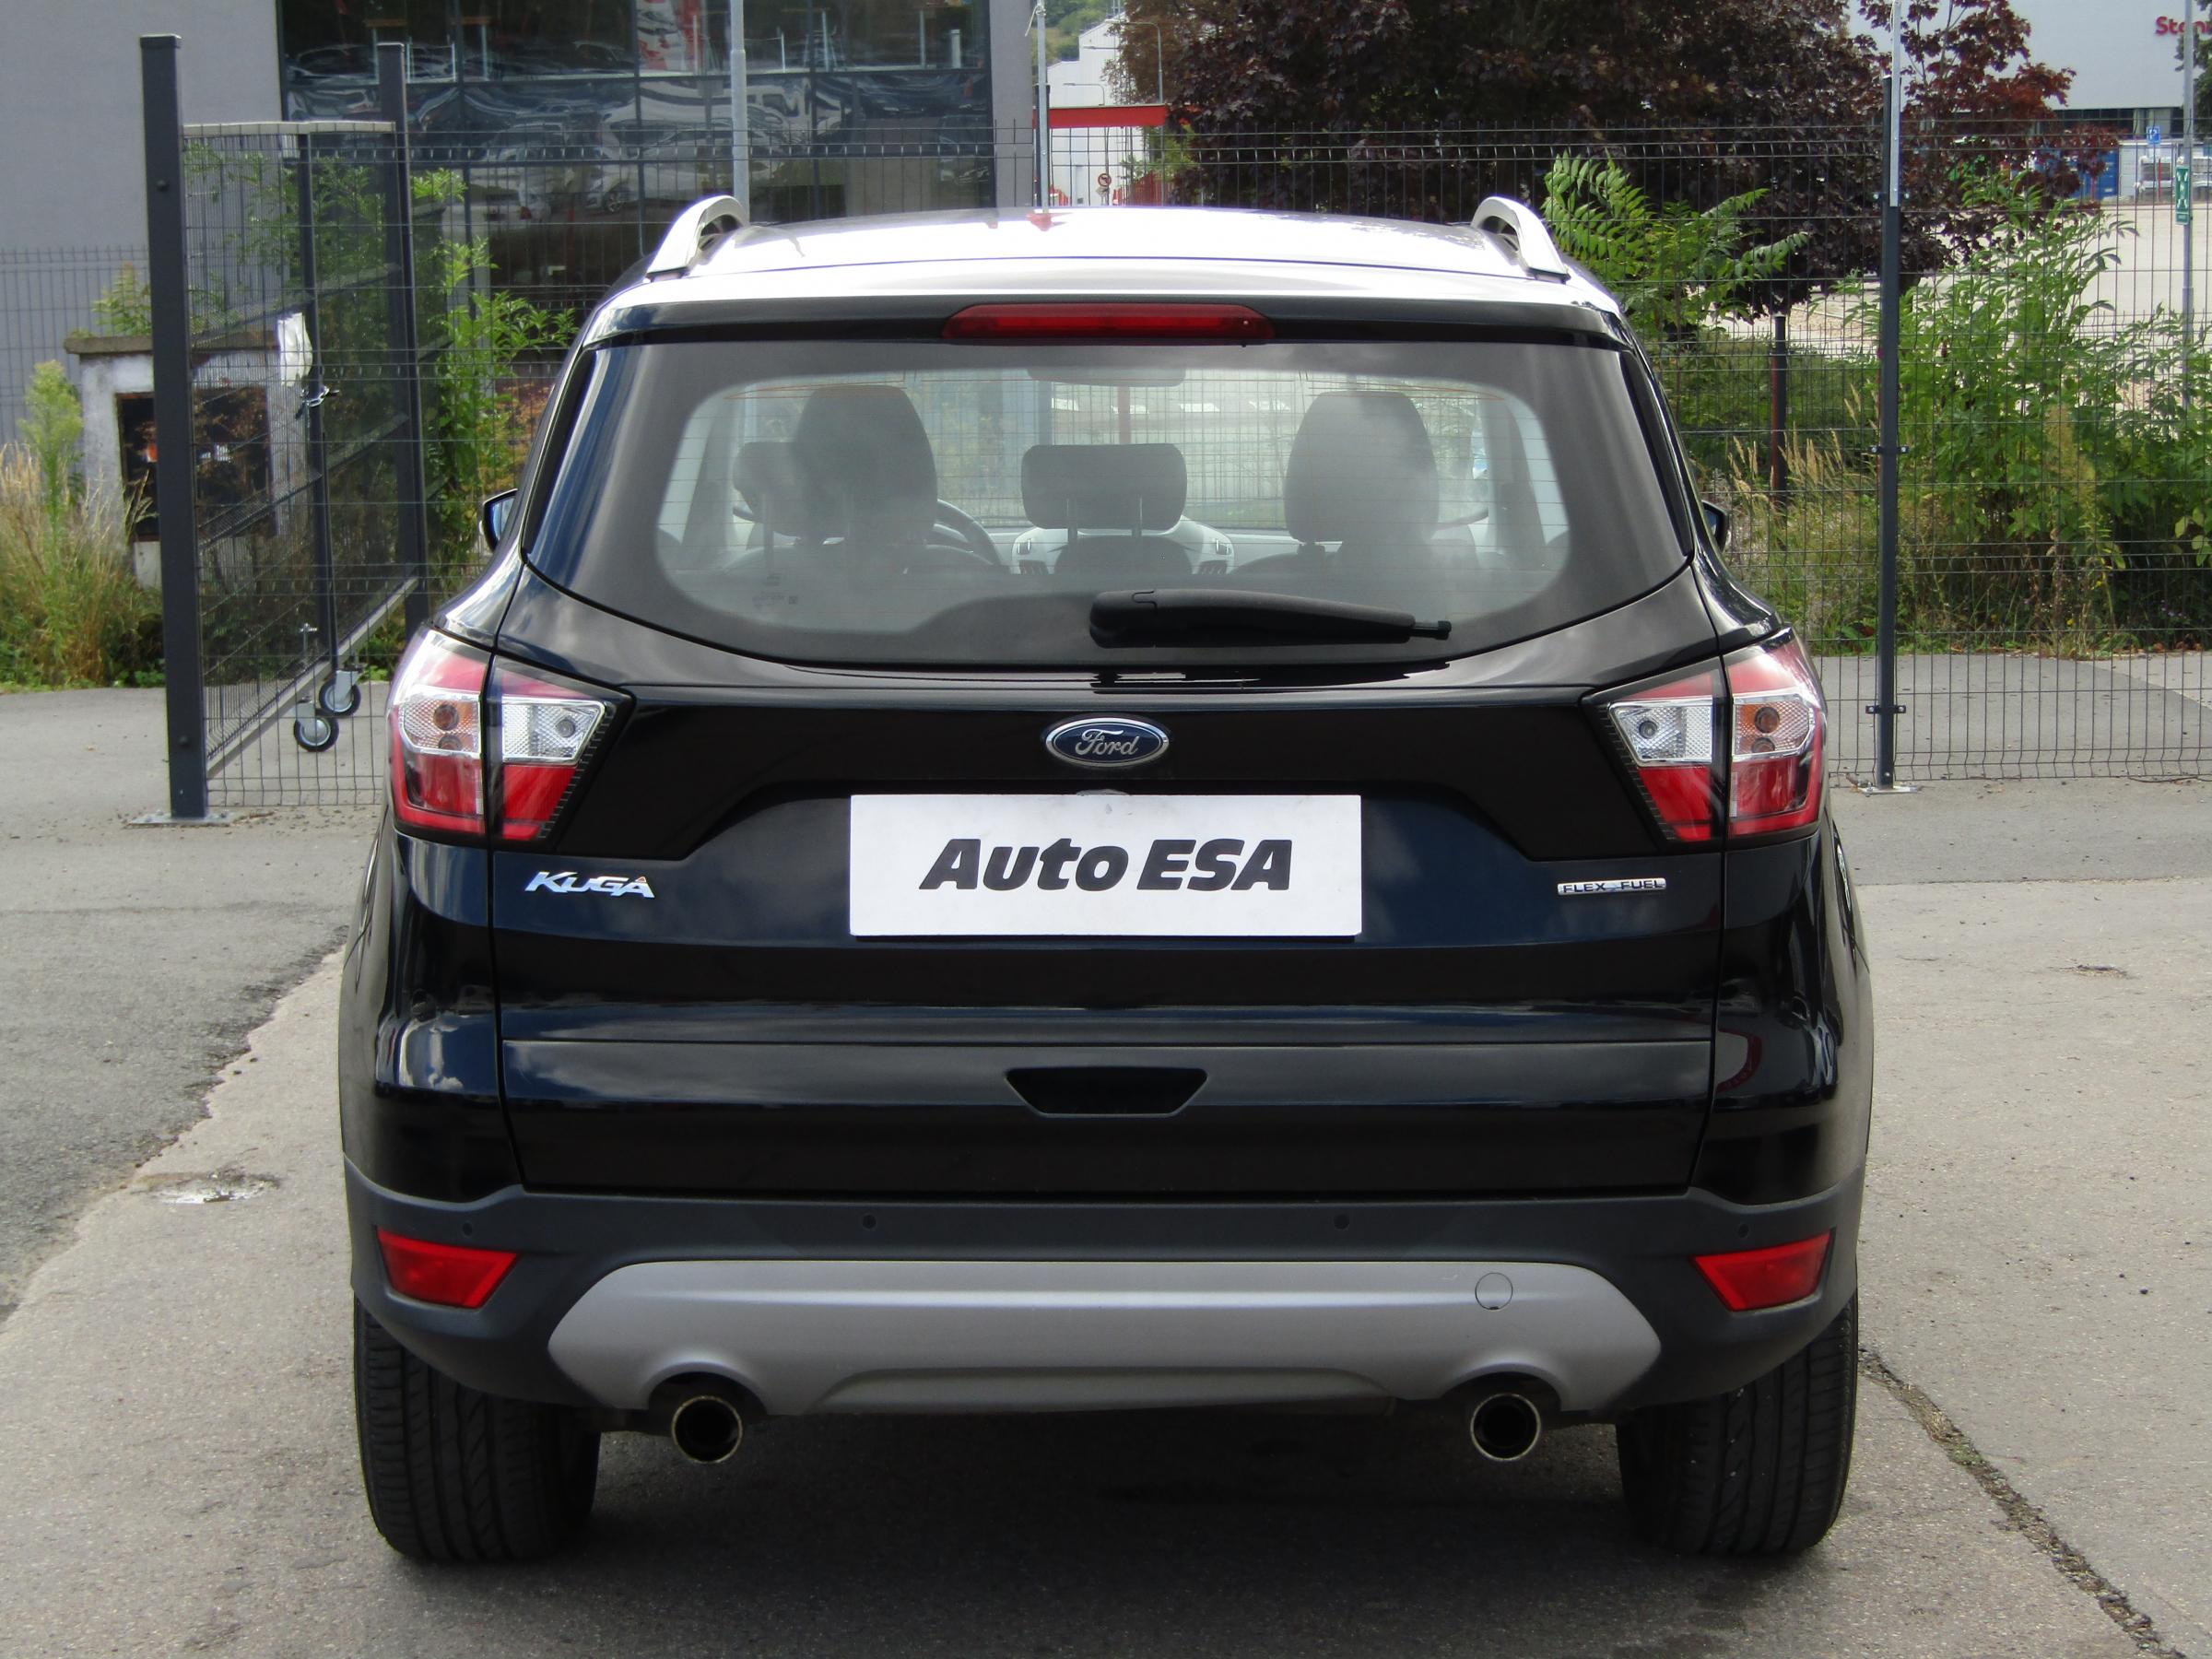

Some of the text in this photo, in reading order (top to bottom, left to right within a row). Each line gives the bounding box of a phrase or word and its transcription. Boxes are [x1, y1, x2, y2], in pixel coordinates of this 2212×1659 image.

[1075, 728, 1140, 755] Ford
[918, 837, 1292, 891] Auto ESA
[524, 871, 655, 899] KUGA
[1563, 879, 1665, 893] FLEX FUEL
